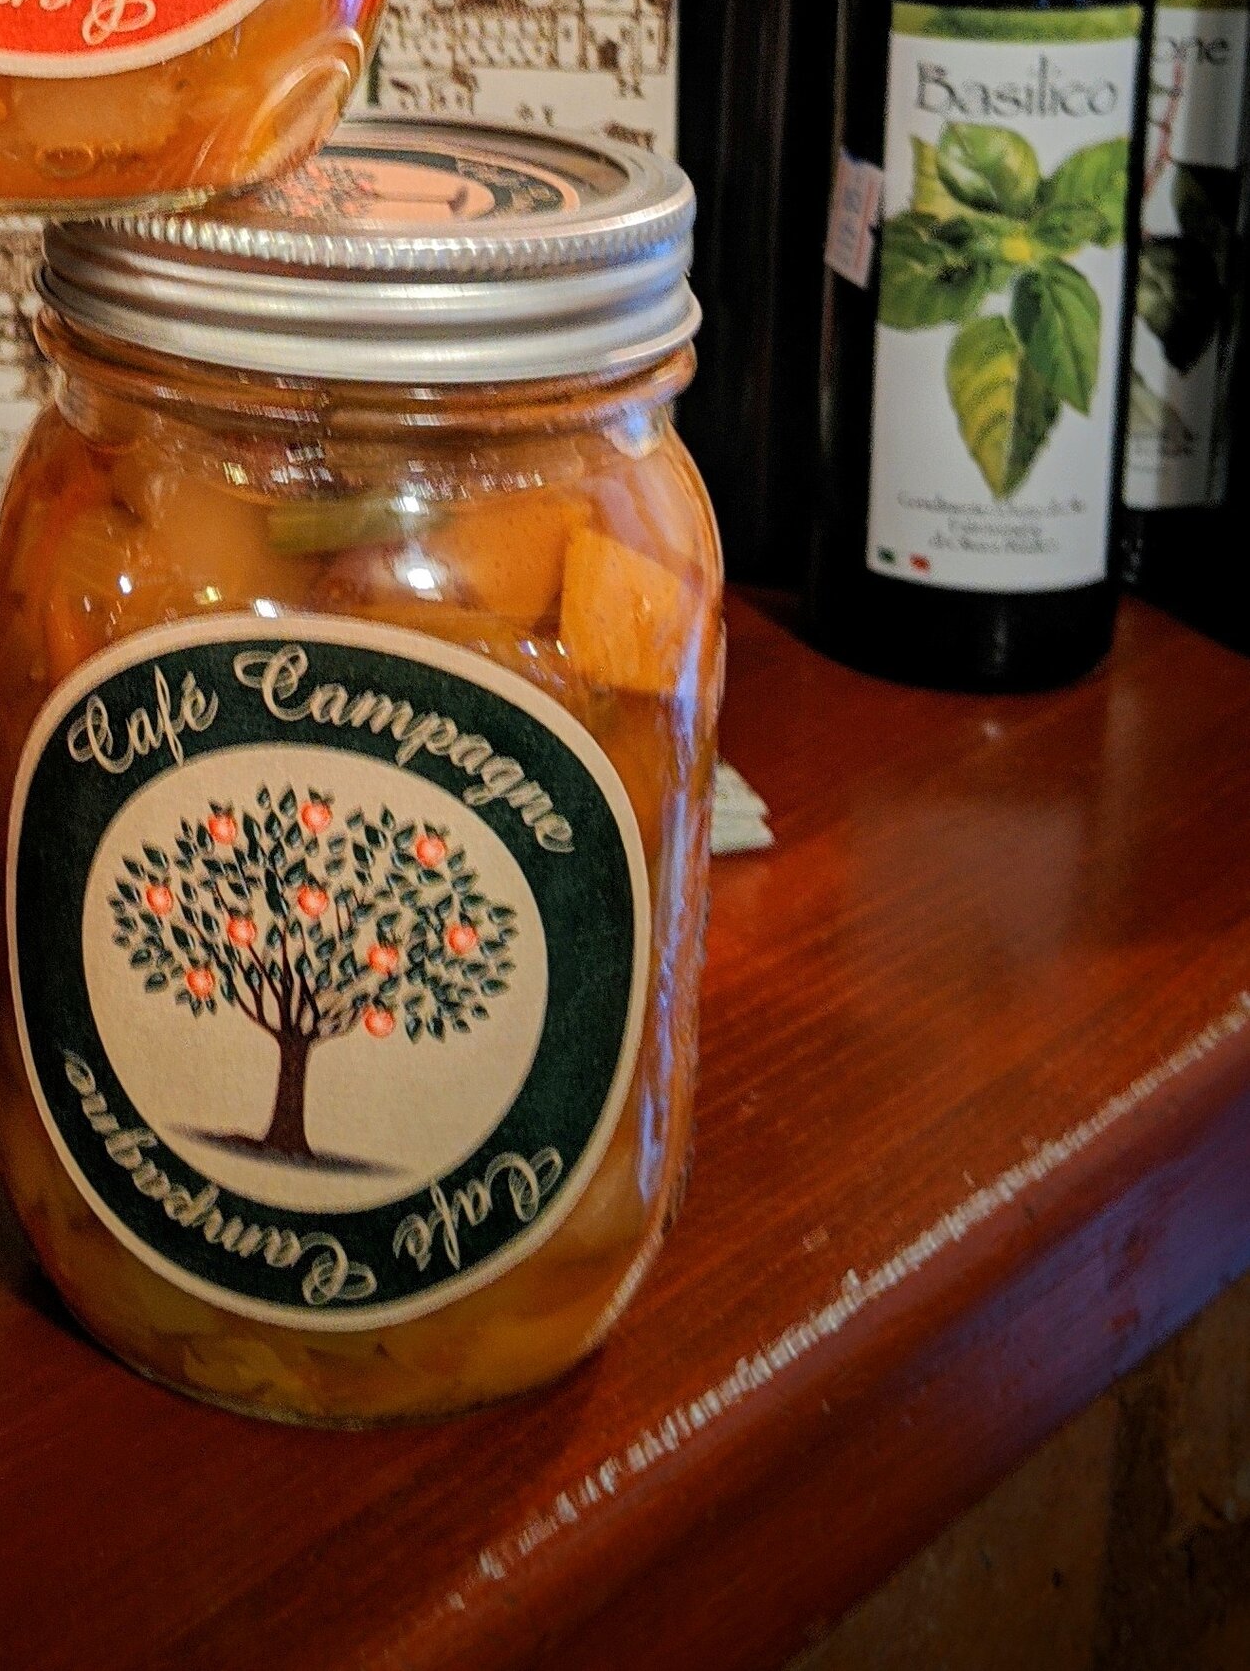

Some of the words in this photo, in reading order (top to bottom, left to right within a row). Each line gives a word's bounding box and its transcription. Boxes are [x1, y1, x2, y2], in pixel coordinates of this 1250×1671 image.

[914, 52, 1121, 118] Basilico
[67, 664, 219, 775] Café
[233, 644, 575, 854] Campagne
[63, 1049, 377, 1307] Campagne
[393, 1146, 563, 1270] Café
